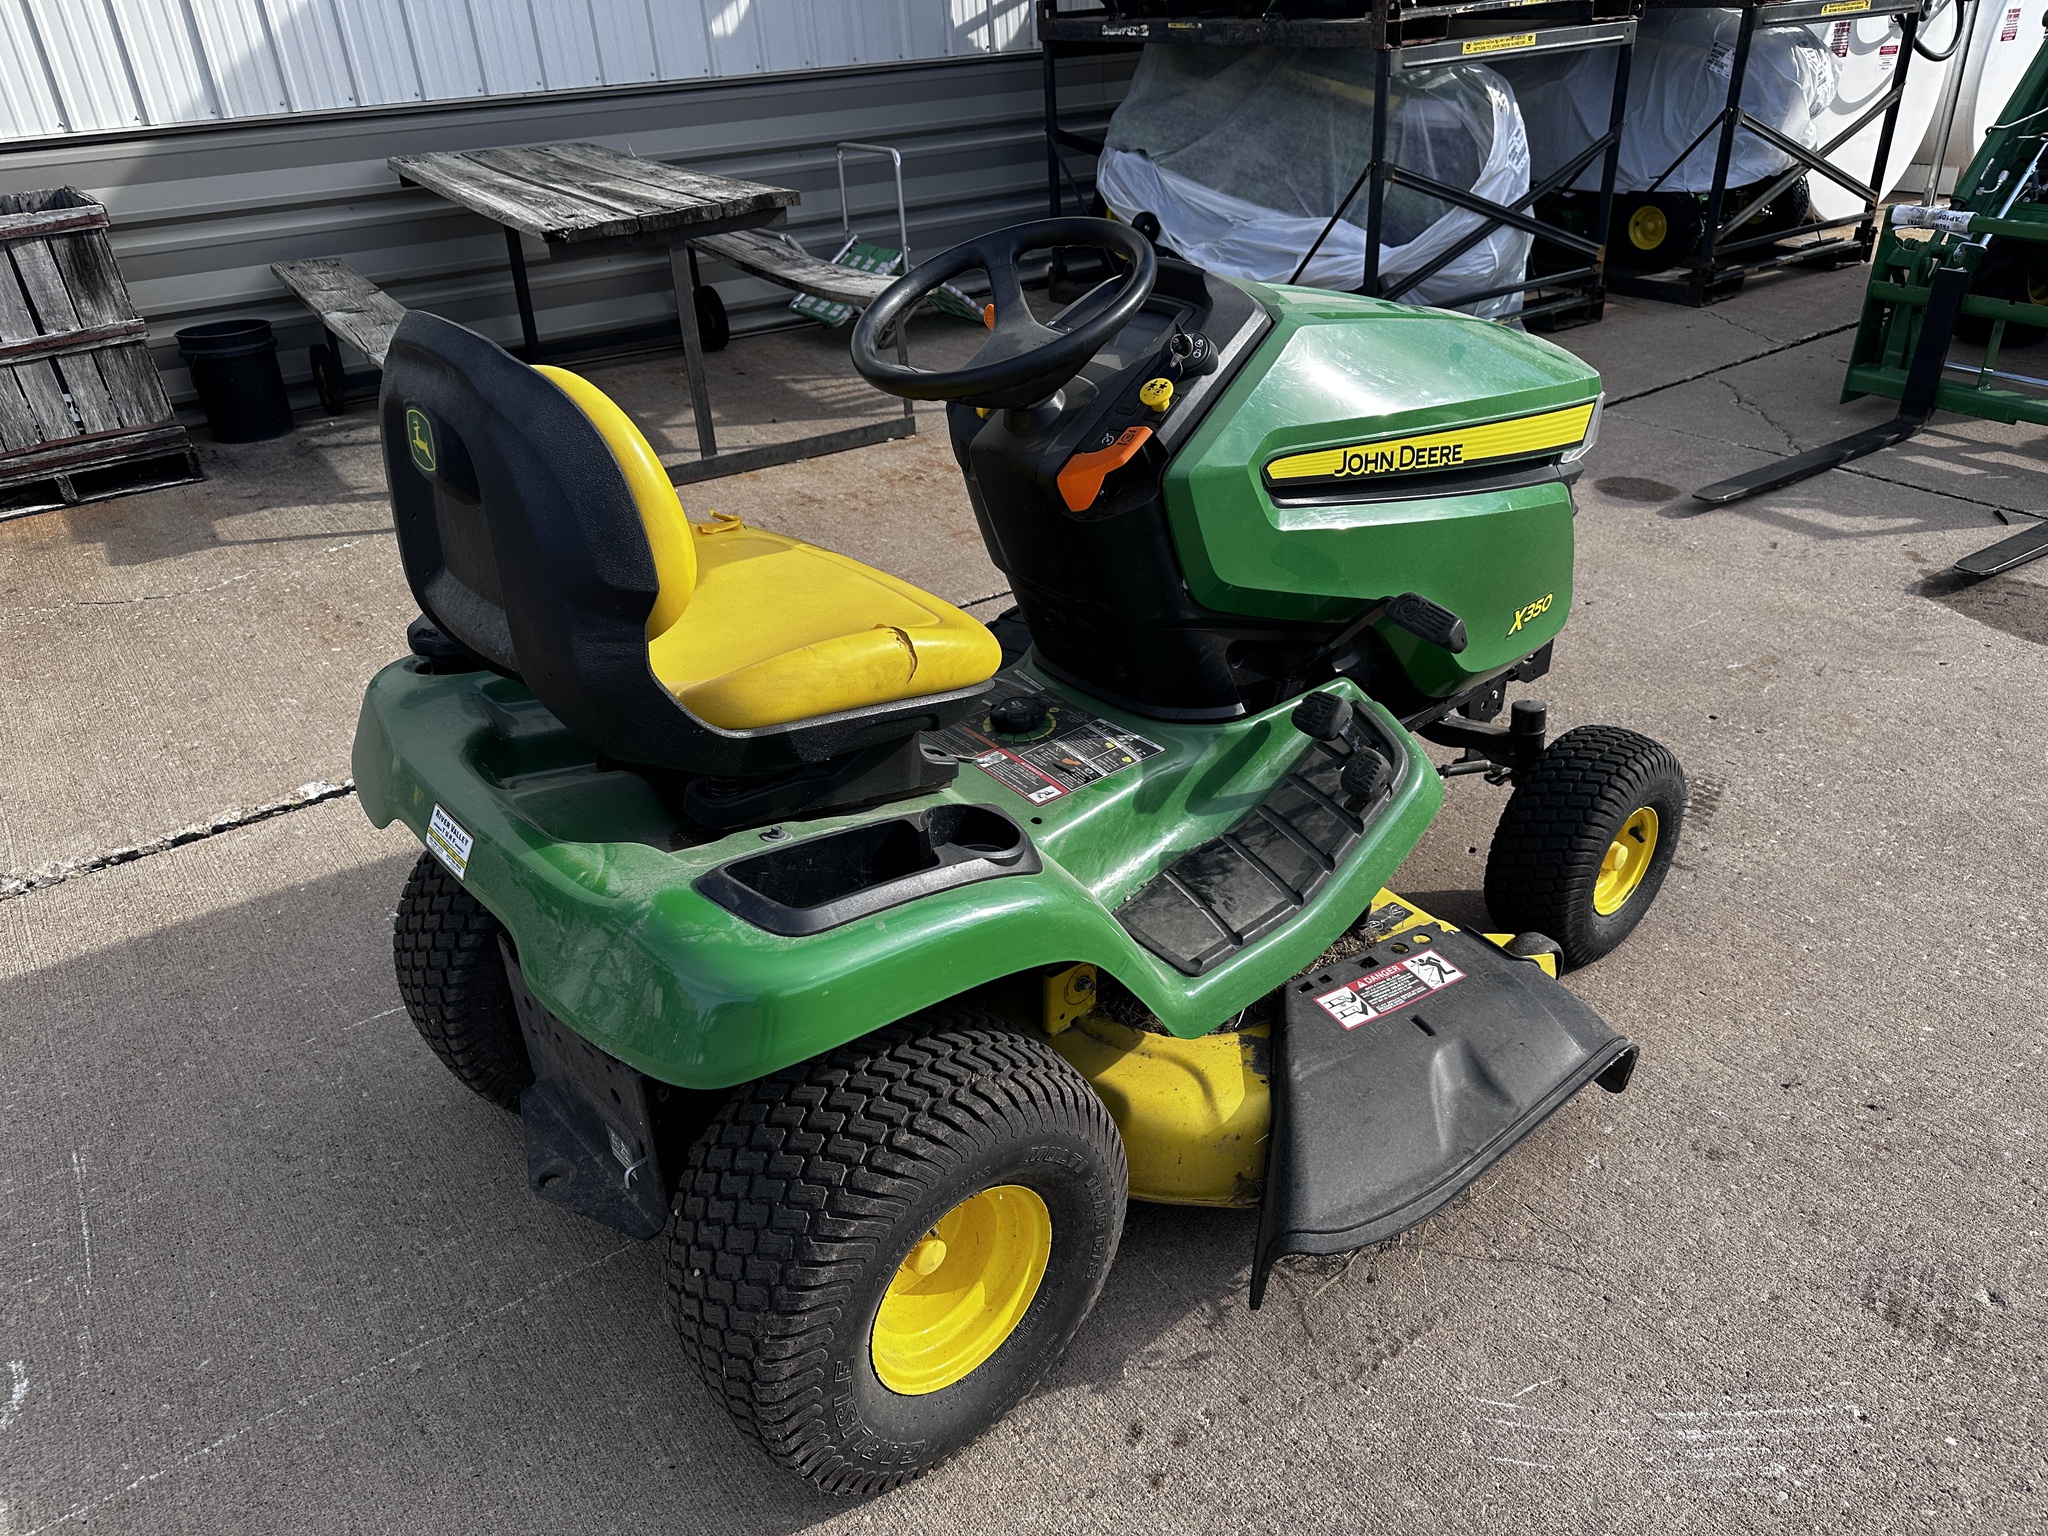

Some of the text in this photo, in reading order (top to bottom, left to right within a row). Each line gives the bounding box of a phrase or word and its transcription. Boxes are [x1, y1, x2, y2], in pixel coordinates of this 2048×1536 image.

[1334, 444, 1464, 475] JOHN DEERE
[1505, 592, 1553, 637] X350
[435, 809, 469, 846] RIVER VALLEY
[442, 827, 456, 844] TURF
[1363, 965, 1401, 984] DANGER
[834, 1355, 926, 1465] CARLISLE
